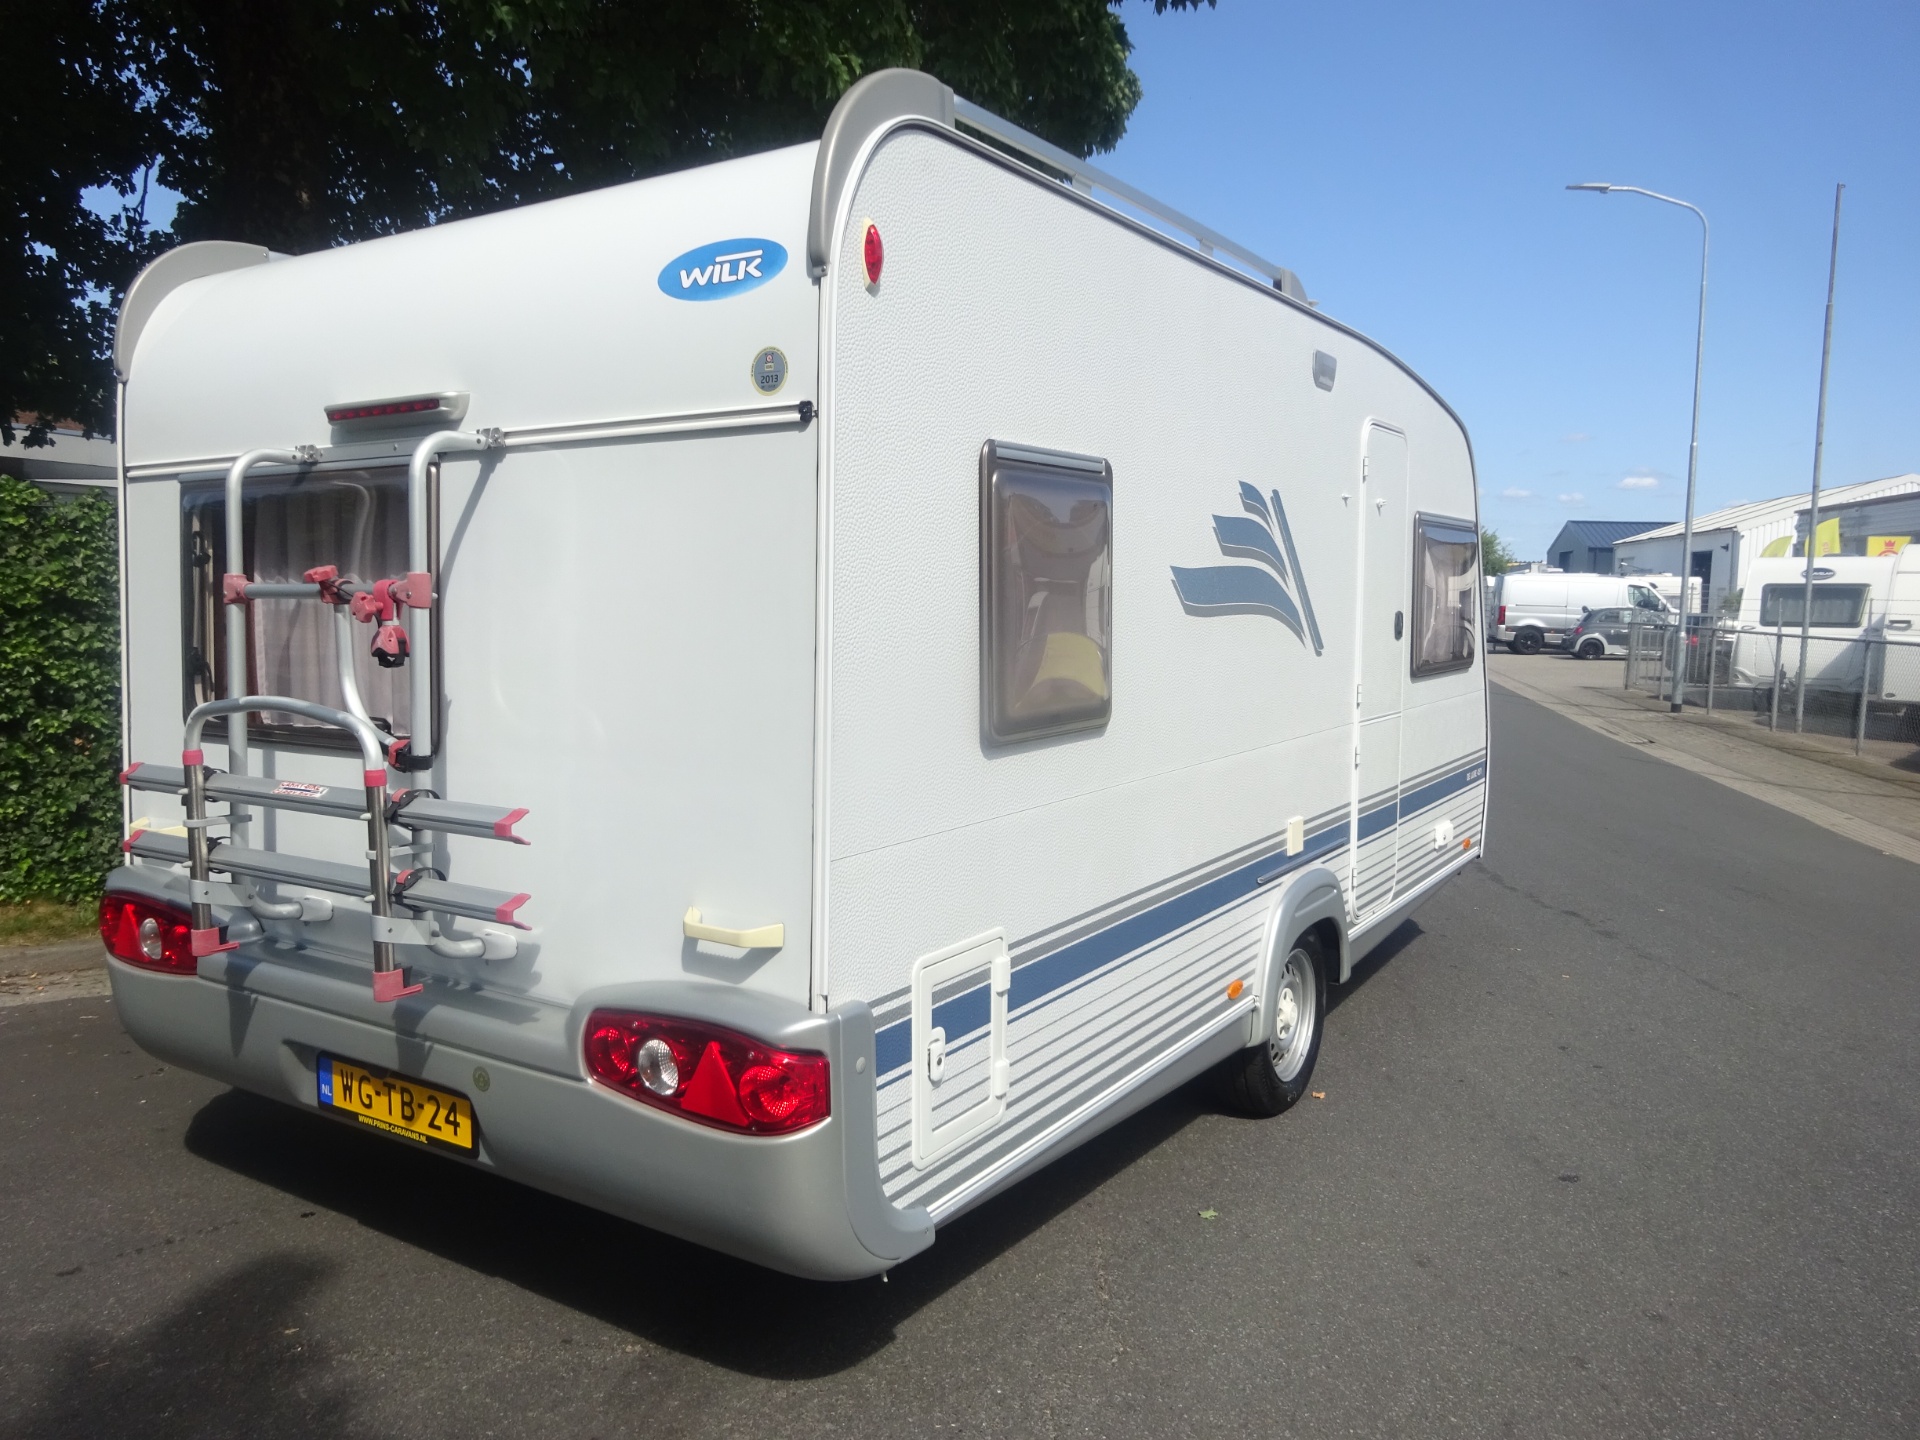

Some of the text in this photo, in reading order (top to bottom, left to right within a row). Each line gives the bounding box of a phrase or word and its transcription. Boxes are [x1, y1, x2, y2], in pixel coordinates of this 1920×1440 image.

[678, 249, 764, 289] WILK
[760, 374, 779, 384] 2013
[321, 1083, 332, 1096] NL
[340, 1068, 461, 1137] WG-TB-24
[357, 1114, 428, 1144] WWW.PRINS-CARAVANS.NL
